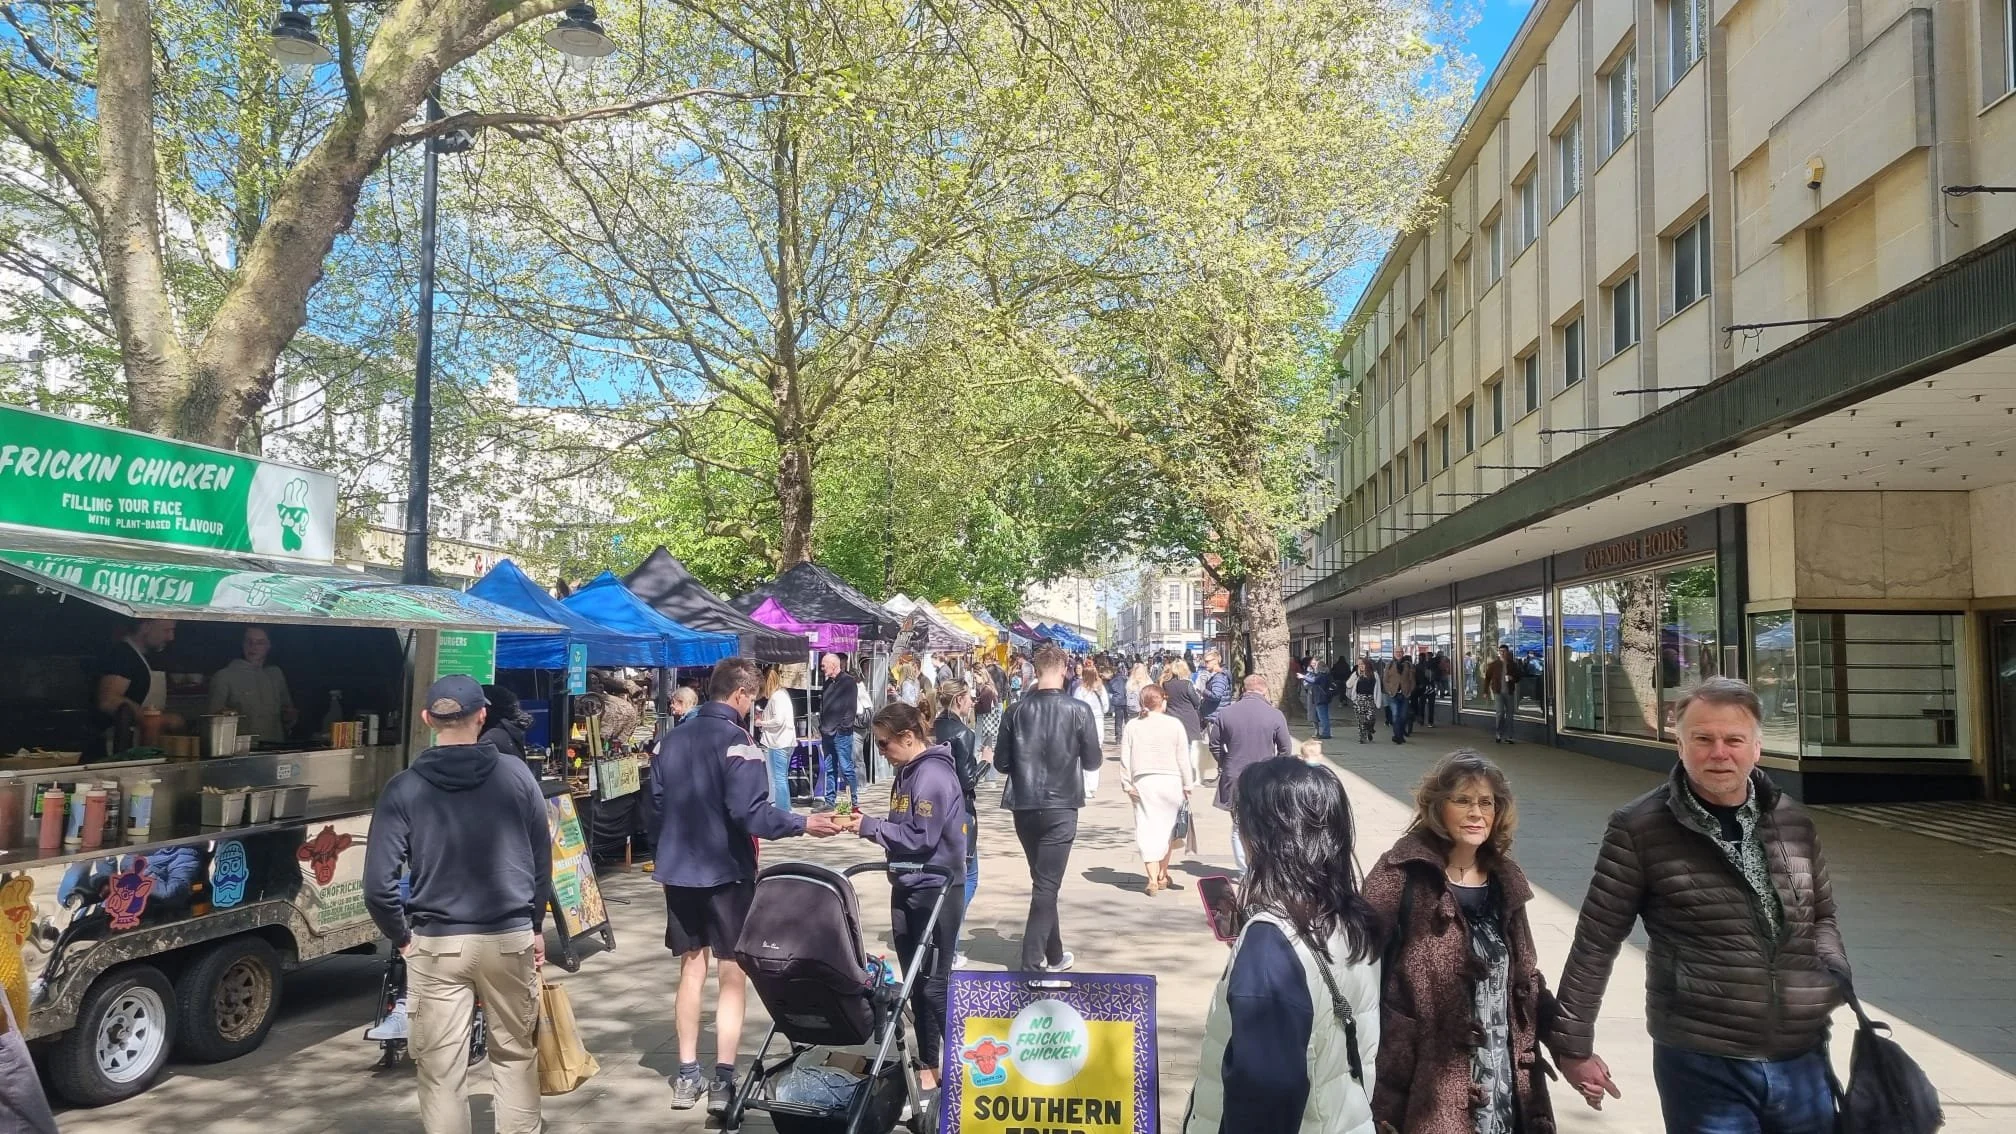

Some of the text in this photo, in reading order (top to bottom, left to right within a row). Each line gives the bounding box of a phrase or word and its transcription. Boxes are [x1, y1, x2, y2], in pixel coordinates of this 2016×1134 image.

[0, 445, 235, 492] FRICKIN CHICKEN
[62, 493, 182, 516] FILLING YOUR FACE
[88, 513, 223, 536] WITH PLANT-BASED FLAVOUR
[1584, 526, 1688, 570] CAVENDISH HOUSE
[1029, 1016, 1053, 1030] NO
[1016, 1028, 1075, 1046] FRICKIN
[1020, 1044, 1082, 1062] CHICKEN
[974, 1095, 1121, 1125] SOUTHERN
